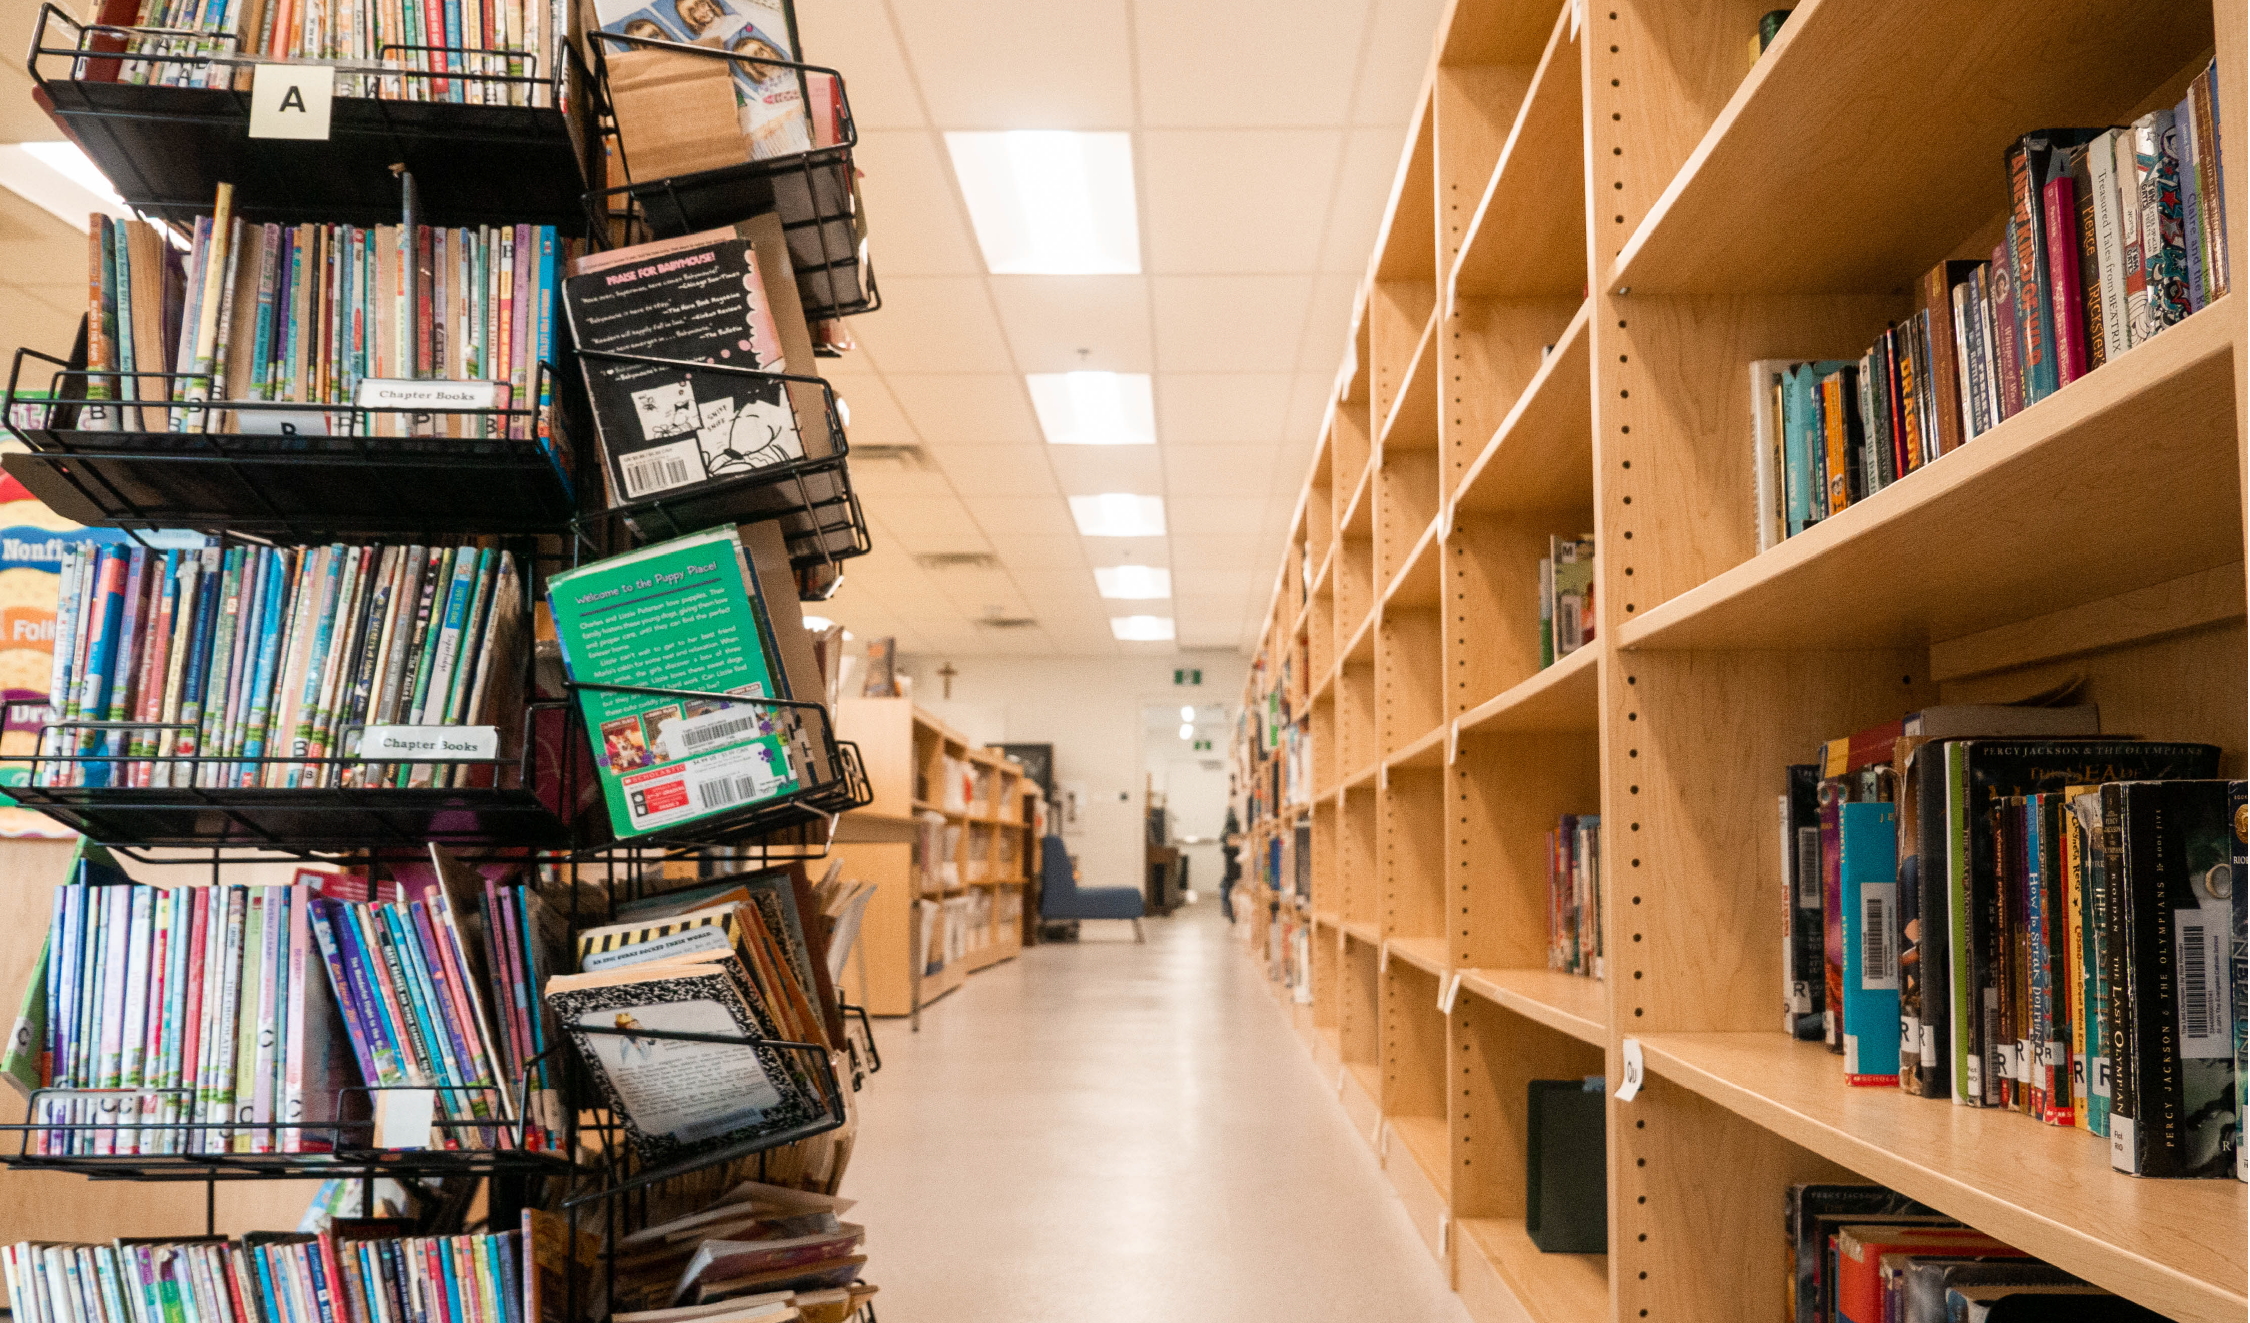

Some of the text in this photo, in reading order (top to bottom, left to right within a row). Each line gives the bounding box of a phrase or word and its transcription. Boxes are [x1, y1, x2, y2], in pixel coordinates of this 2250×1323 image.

[279, 86, 306, 112] A
[2097, 169, 2111, 228] Treasured
[2082, 205, 2097, 255] PIERCE
[2186, 193, 2204, 291] Claire and the
[2102, 232, 2114, 261] Tales
[605, 270, 636, 285] PRAISE
[637, 265, 657, 278] FOR
[656, 251, 715, 273] BABYMOUSE!
[2011, 155, 2041, 369] A NEW KIND OF WAR
[2105, 263, 2115, 292] from
[2056, 312, 2065, 334] Jean
[2108, 294, 2120, 353] BEATRIX
[1969, 351, 1977, 382] BATTLE
[2003, 326, 2017, 403] Whispers of War
[2058, 338, 2068, 378] Fashion
[380, 390, 475, 400] Chapter Books
[91, 406, 106, 420] B
[1899, 357, 1919, 469] DRAGON
[1865, 433, 1873, 457] THE
[575, 559, 717, 605] Welcome to the Puppy Place!
[585, 641, 598, 649] and
[653, 623, 667, 632] they
[695, 612, 707, 620] the
[604, 615, 617, 623] and
[294, 742, 307, 757] B
[383, 738, 436, 751] Chapter
[2024, 747, 2079, 757] JACKSON
[2070, 816, 2081, 891] Gwyneth Rees
[1962, 890, 1971, 949] MONSTERS
[2156, 880, 2167, 963] OLYMPIANS
[349, 956, 359, 969] The
[384, 944, 396, 965] MATH
[390, 965, 404, 992] RASHES
[2111, 956, 2119, 980] THE
[353, 968, 369, 1000] Wonderful
[1794, 983, 1805, 997] R
[2160, 973, 2168, 998] THE
[2112, 984, 2122, 1025] LAST
[368, 1018, 376, 1027] to
[1998, 1053, 2007, 1074] R
[2034, 1046, 2044, 1066] R
[2045, 1048, 2052, 1059] R
[2161, 1024, 2172, 1091] JACKSON
[2074, 1061, 2084, 1083] R
[2113, 1030, 2125, 1113] OLYMPIAN
[2164, 1101, 2174, 1147] PERCY
[2223, 1141, 2230, 1151] R
